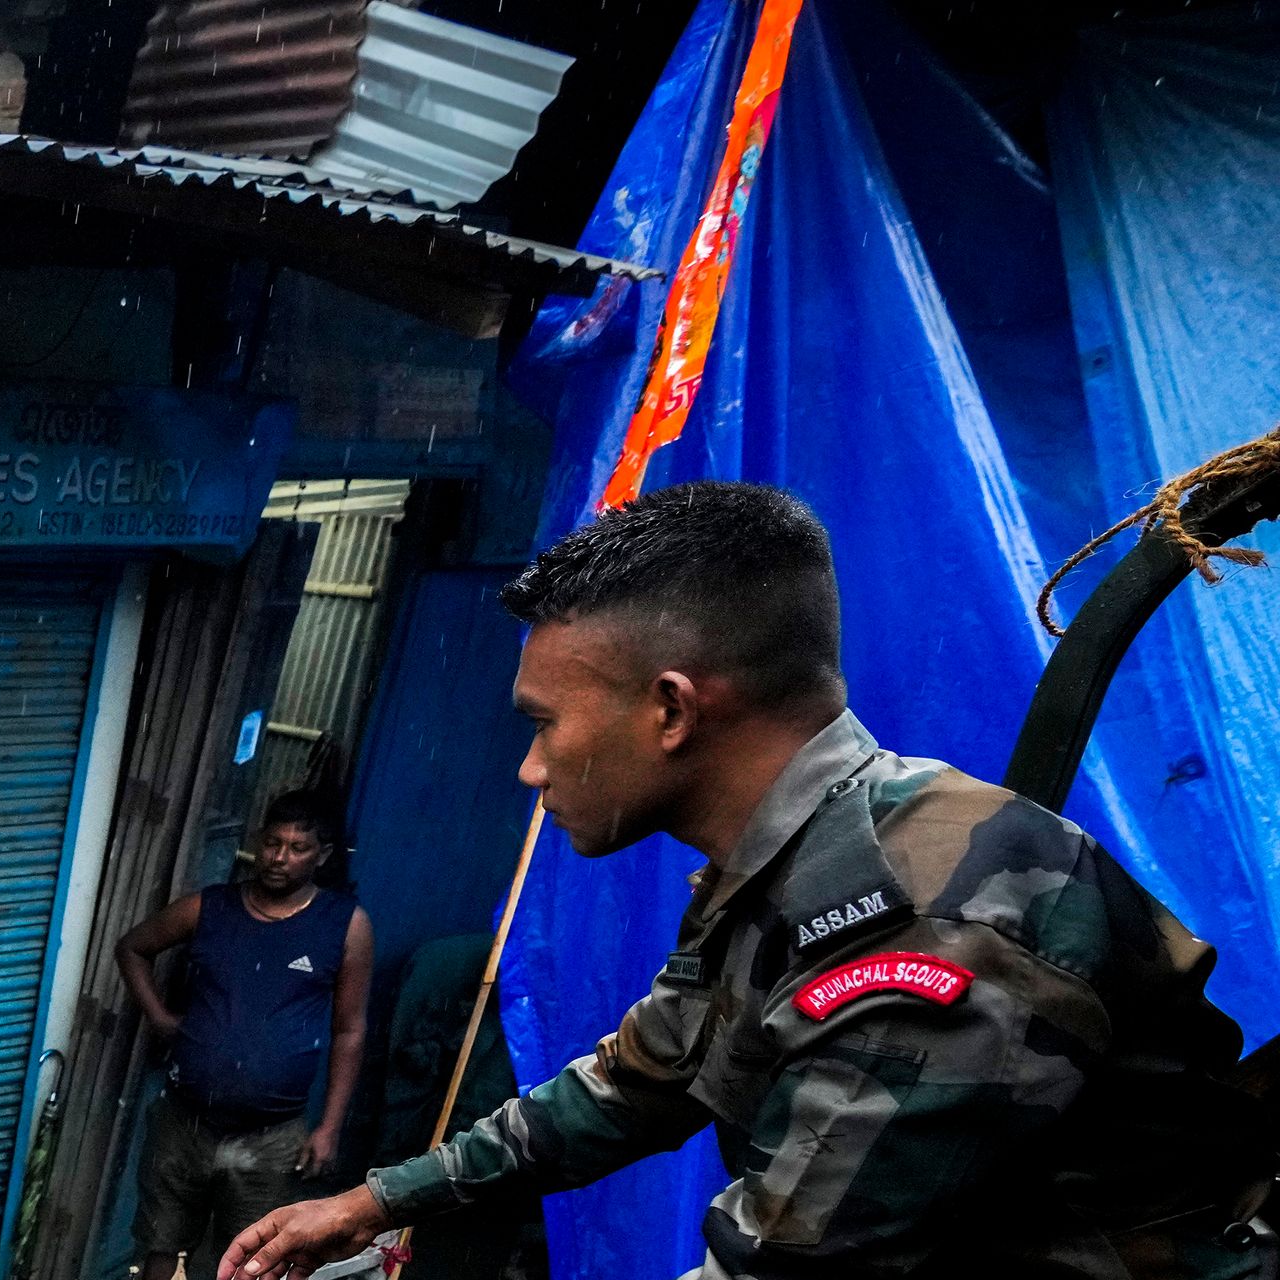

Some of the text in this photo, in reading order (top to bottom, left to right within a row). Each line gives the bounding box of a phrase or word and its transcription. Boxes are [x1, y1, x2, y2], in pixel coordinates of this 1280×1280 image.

[58, 455, 201, 504] AGENCY
[797, 891, 889, 948] ASSAM
[807, 962, 958, 1010] ARUNACHAL SCOUTS
